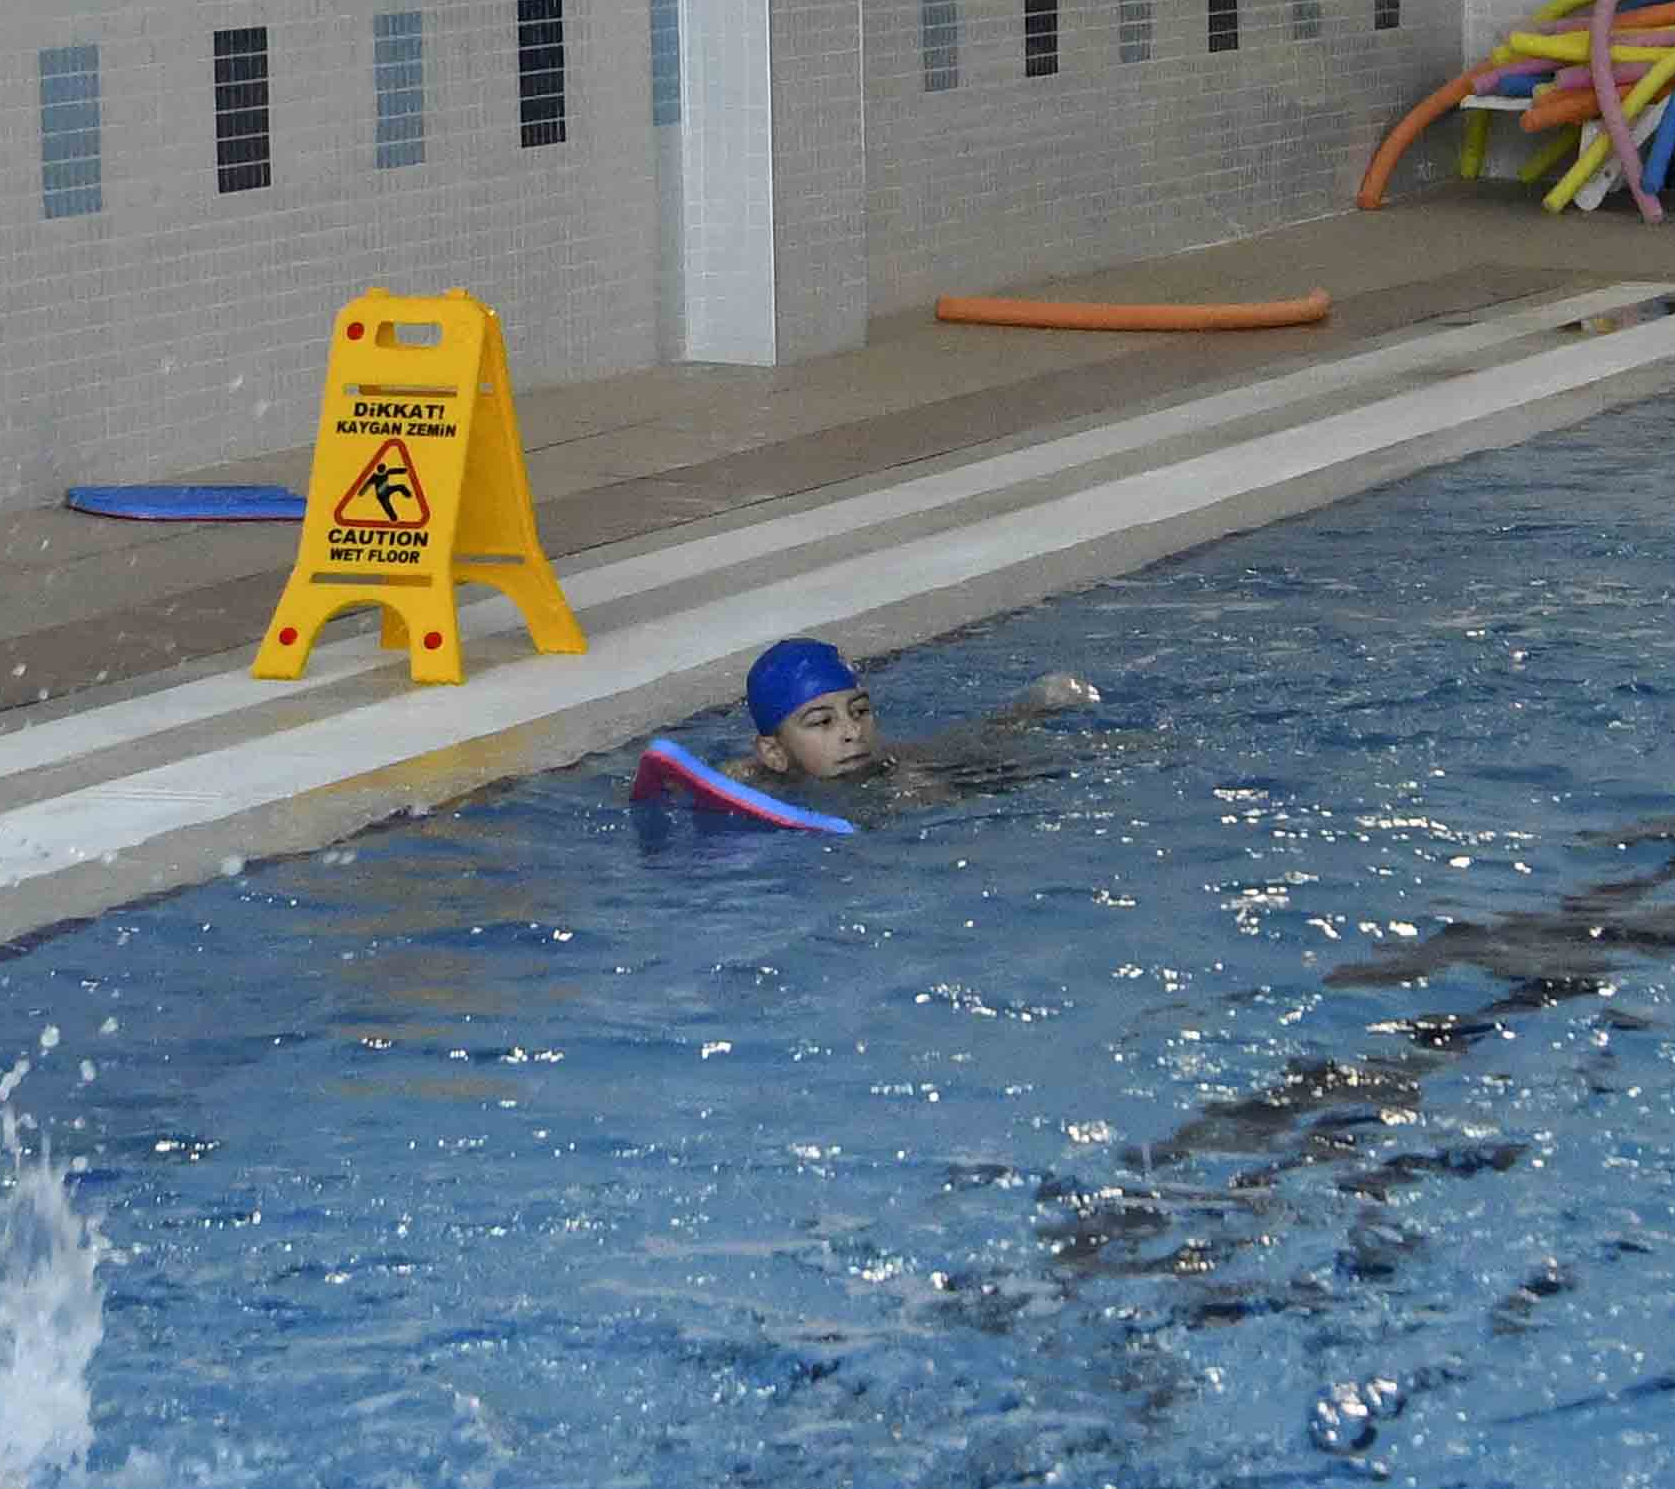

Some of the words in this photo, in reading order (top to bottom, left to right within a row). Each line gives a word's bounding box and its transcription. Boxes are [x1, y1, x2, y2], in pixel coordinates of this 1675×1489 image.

[336, 420, 402, 436] KAYGAN
[328, 528, 429, 547] CAUTION
[330, 548, 364, 562] WET
[368, 549, 420, 564] FLOOR
